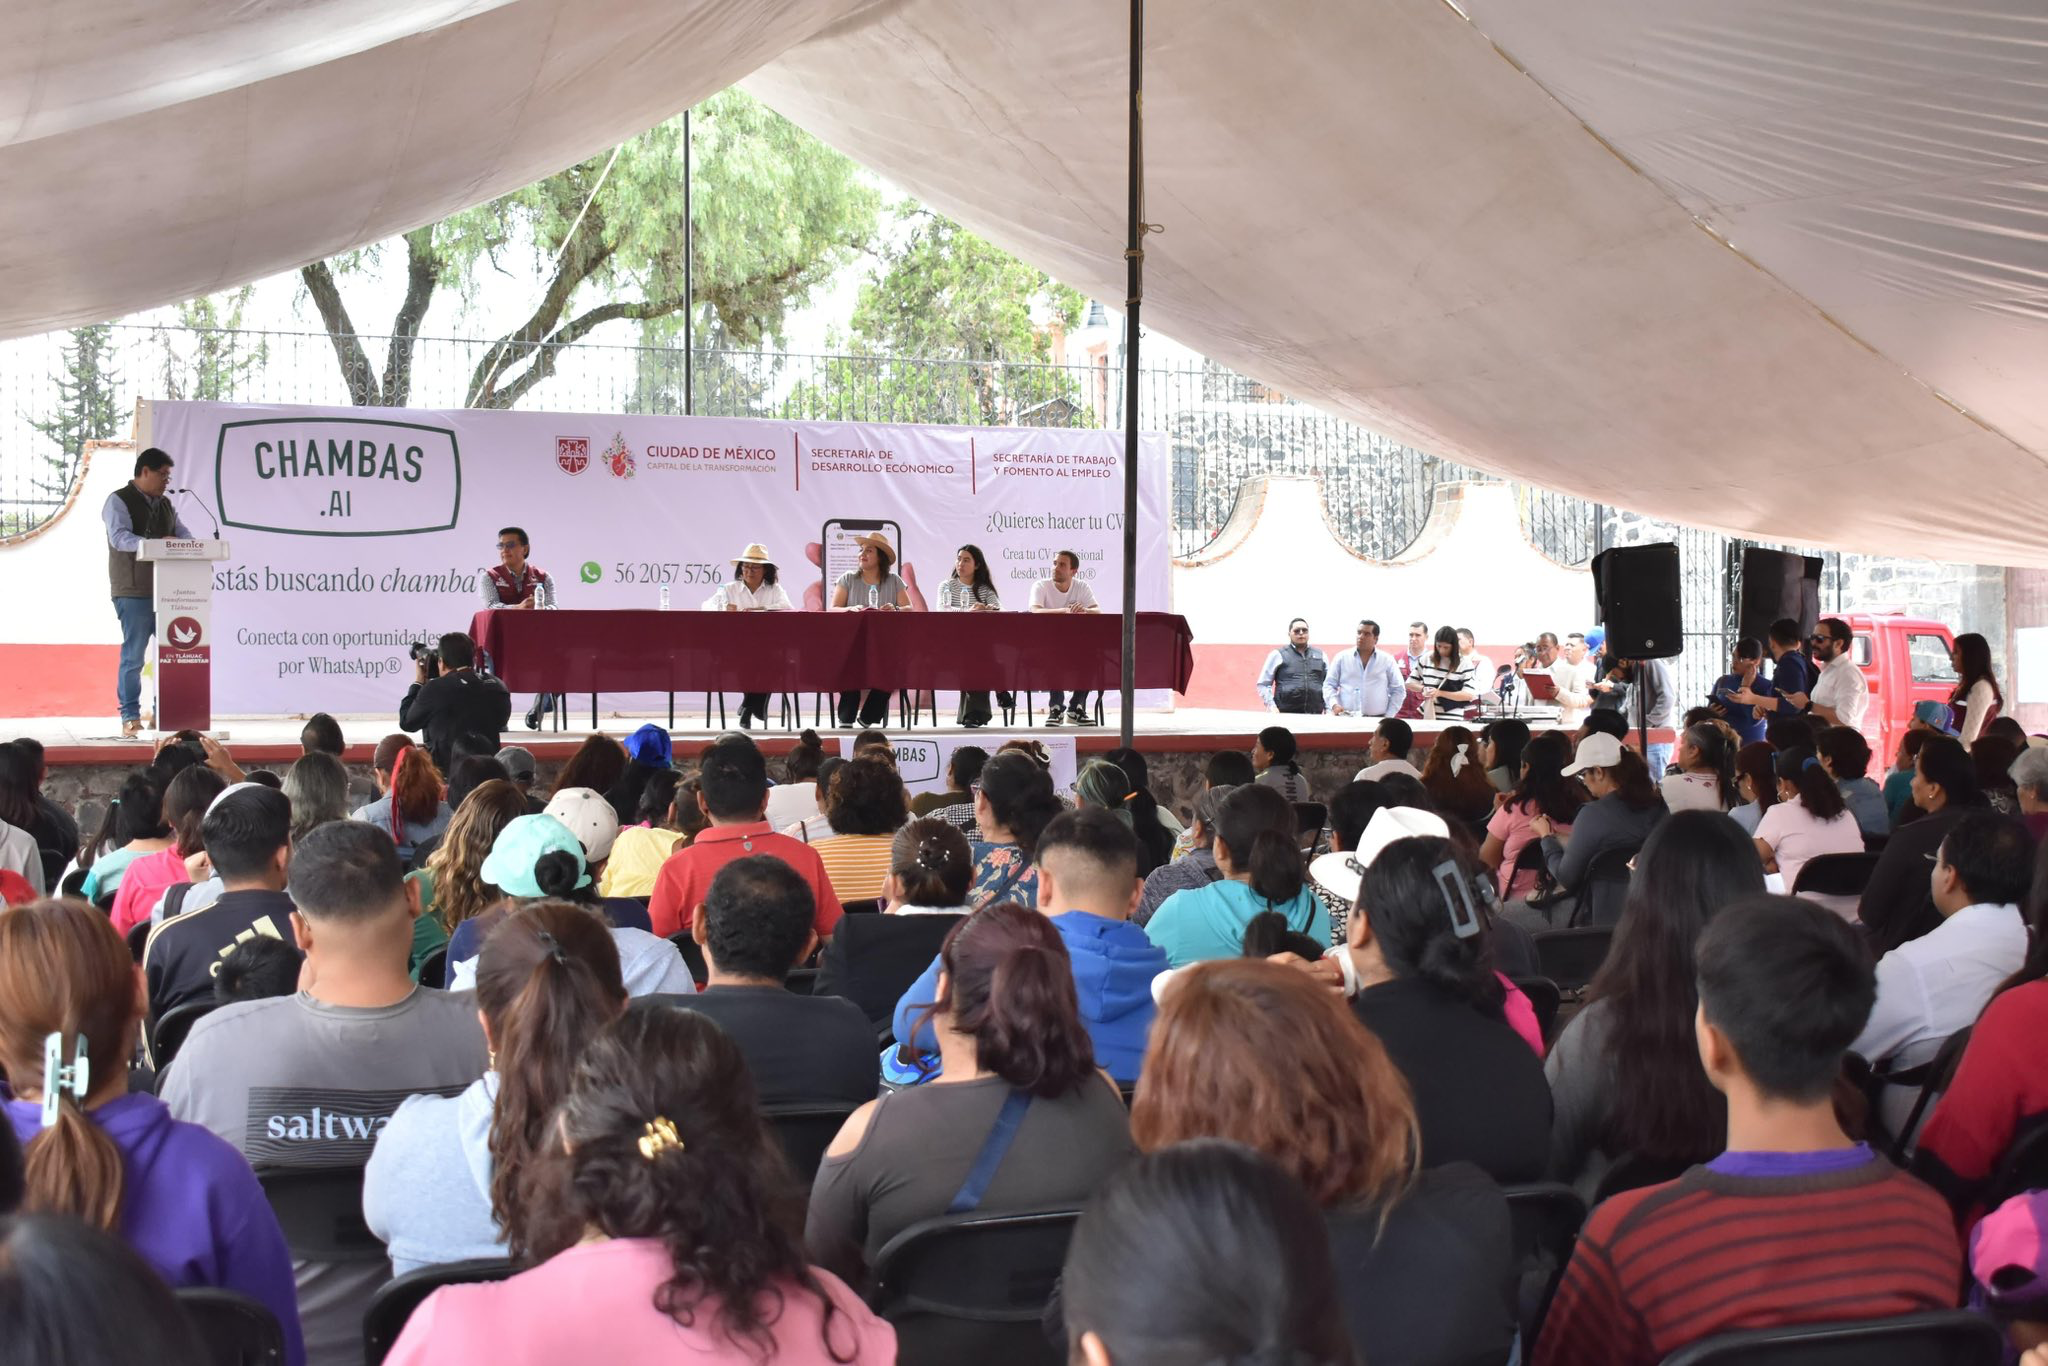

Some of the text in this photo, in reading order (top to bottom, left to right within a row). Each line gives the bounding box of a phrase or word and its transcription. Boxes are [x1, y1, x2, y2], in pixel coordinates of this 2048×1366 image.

[255, 439, 424, 483] CHAMBAS
[647, 445, 776, 461] CIUDAD DE MÉXICO
[811, 448, 893, 460] SECRETARÍA DE
[993, 453, 1117, 467] SECRETARÍA DE TRABAJO
[647, 462, 678, 470] CAPITAL
[680, 463, 690, 471] DE
[692, 463, 702, 471] LA
[811, 462, 882, 473] DESARROLLO
[993, 466, 1111, 478] Y FOMENTO AL EMPLEO
[320, 490, 351, 517] .AI
[986, 511, 1044, 533] ¿Quieres
[1048, 512, 1085, 530] hacer
[1089, 516, 1102, 530] tu
[1002, 547, 1024, 560] Crea
[1026, 550, 1036, 560] tu
[1038, 548, 1051, 561] CV
[211, 565, 259, 591] stás
[265, 566, 375, 593] buscando
[615, 562, 722, 585] 56 2057 5756
[1010, 567, 1038, 580] desde
[237, 628, 442, 649] Conecta con oportunidades
[279, 661, 304, 679] por
[892, 746, 926, 763] MBAS
